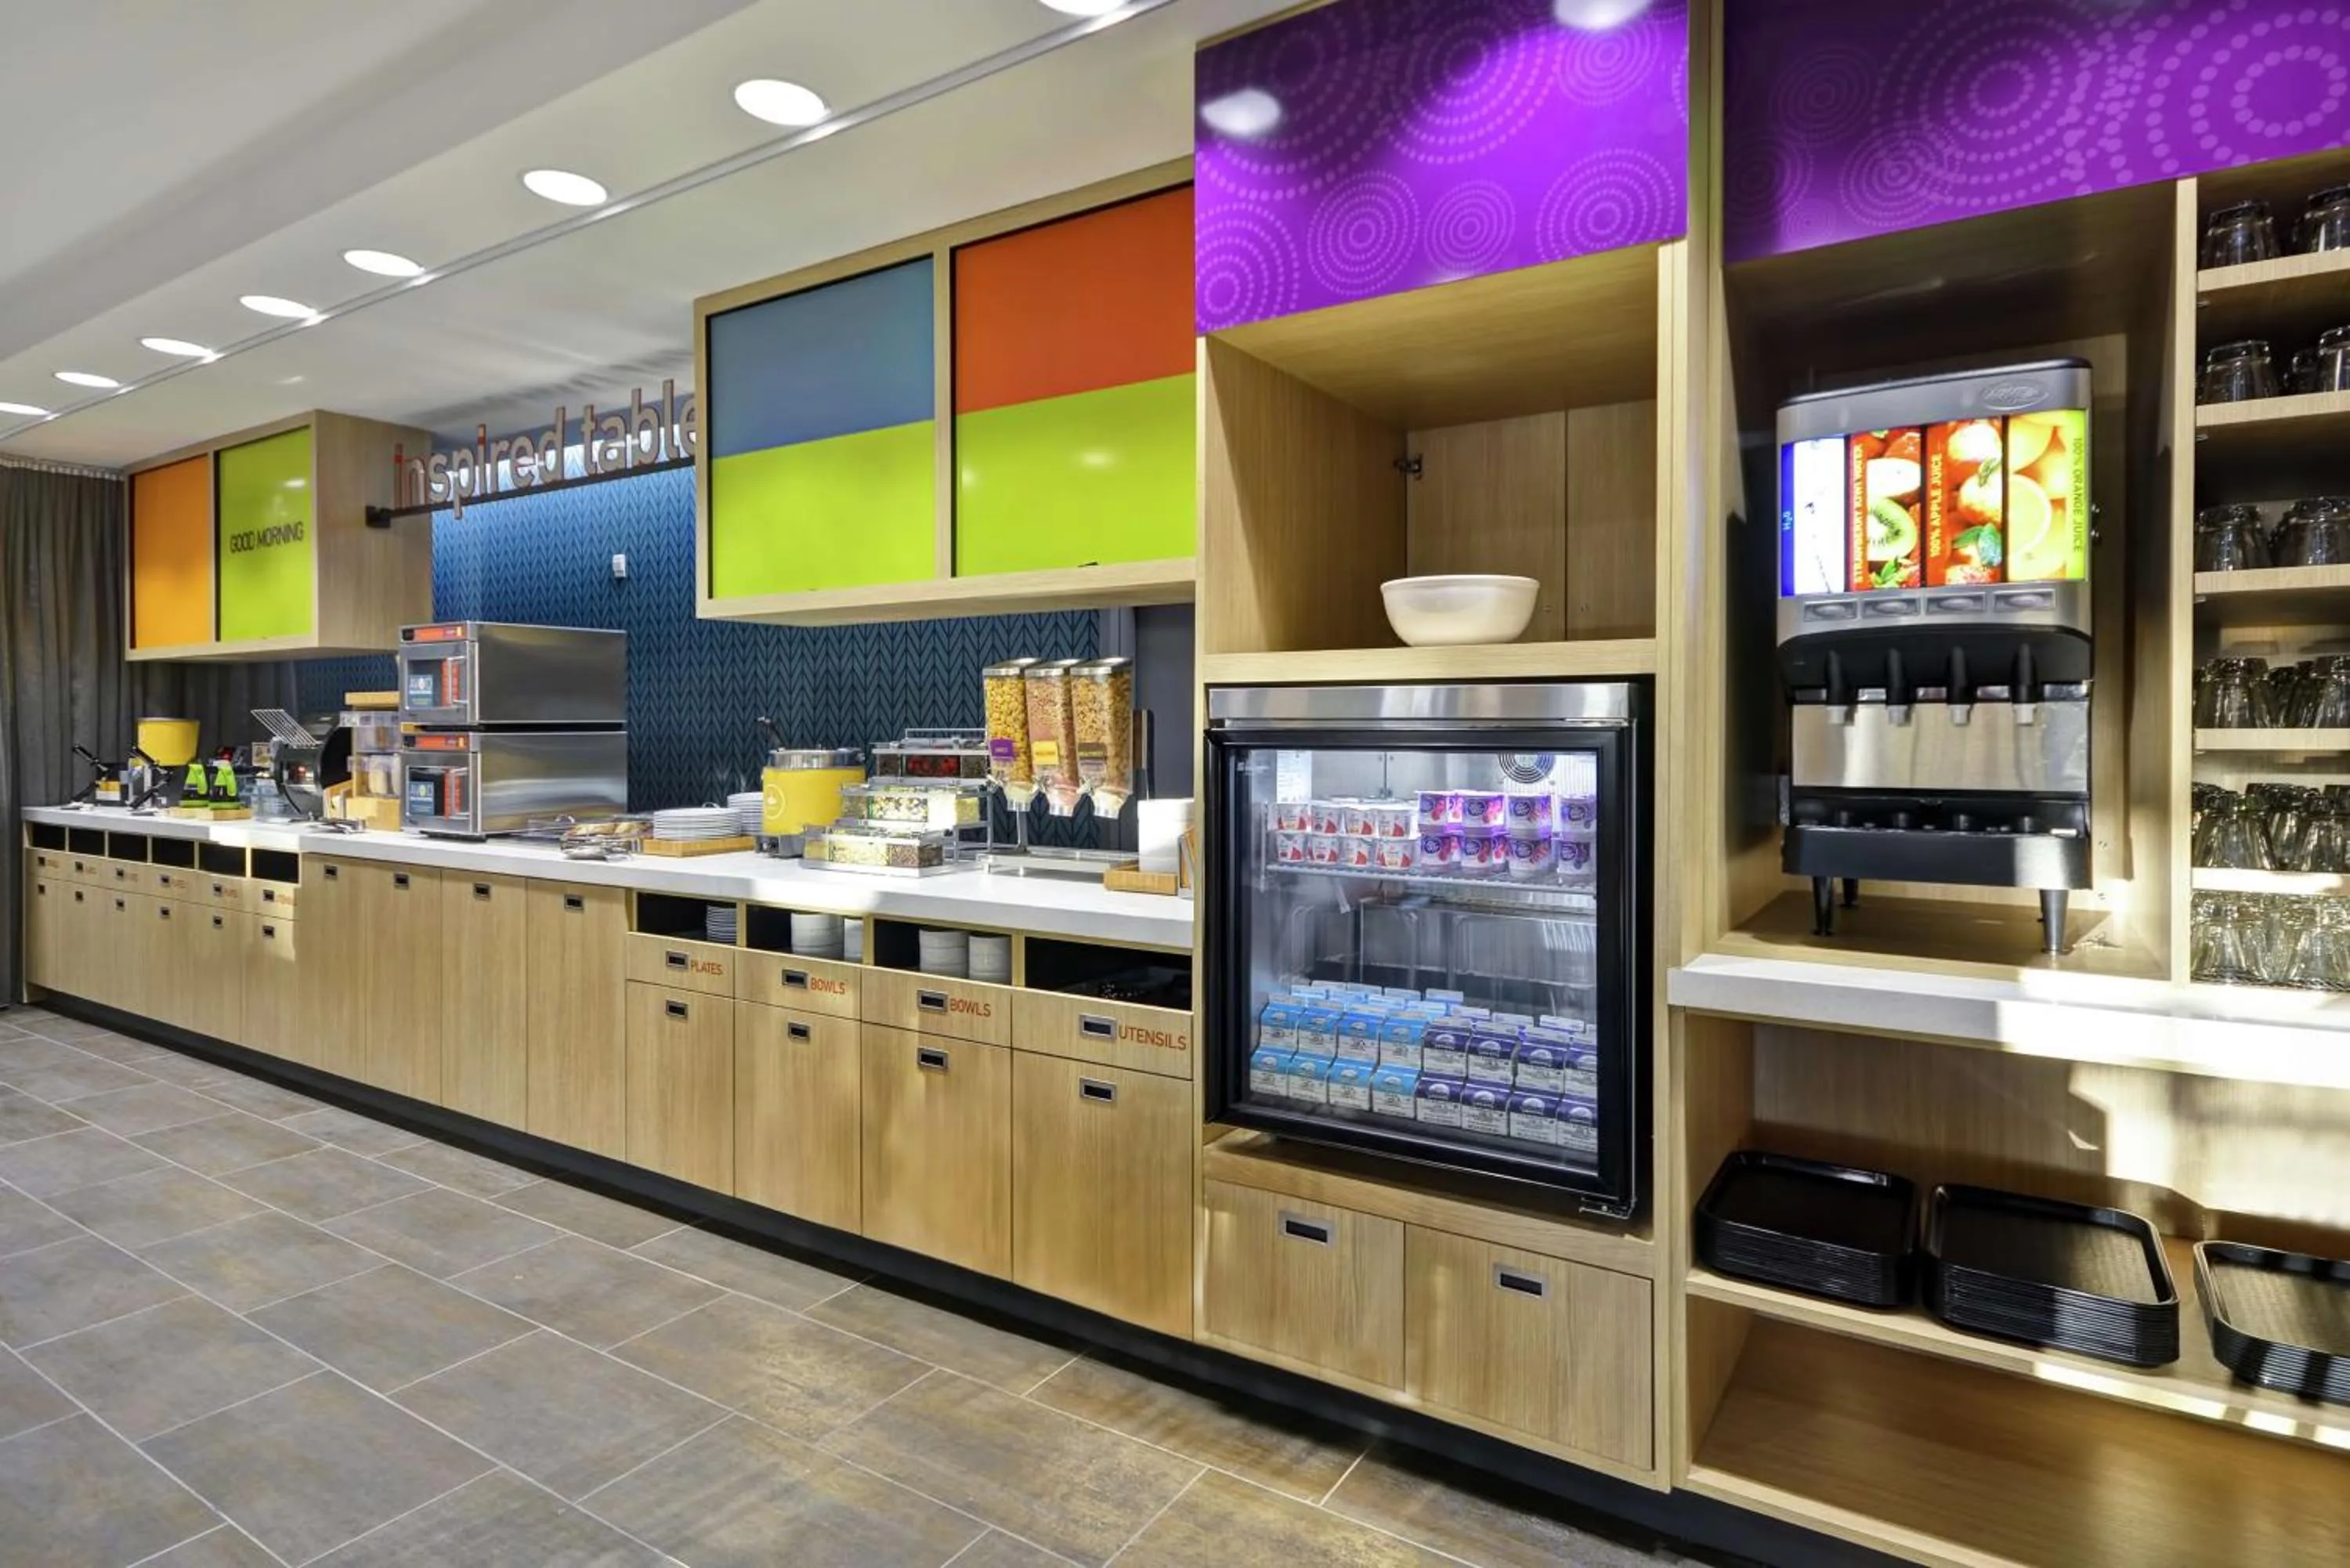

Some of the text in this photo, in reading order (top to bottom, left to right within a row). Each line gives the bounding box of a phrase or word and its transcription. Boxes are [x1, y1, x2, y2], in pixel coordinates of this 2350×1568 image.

[395, 406, 566, 520] inspired
[1929, 453, 1943, 558] 100% APPLE JUICE
[2073, 437, 2084, 552] 100% ORANGE JUICE
[230, 520, 304, 554] GOOD MORNING
[690, 959, 724, 976] PLATES
[810, 977, 845, 995] BOWLS
[949, 998, 991, 1017] BOWLS
[1118, 1024, 1188, 1051] UTENSILS
